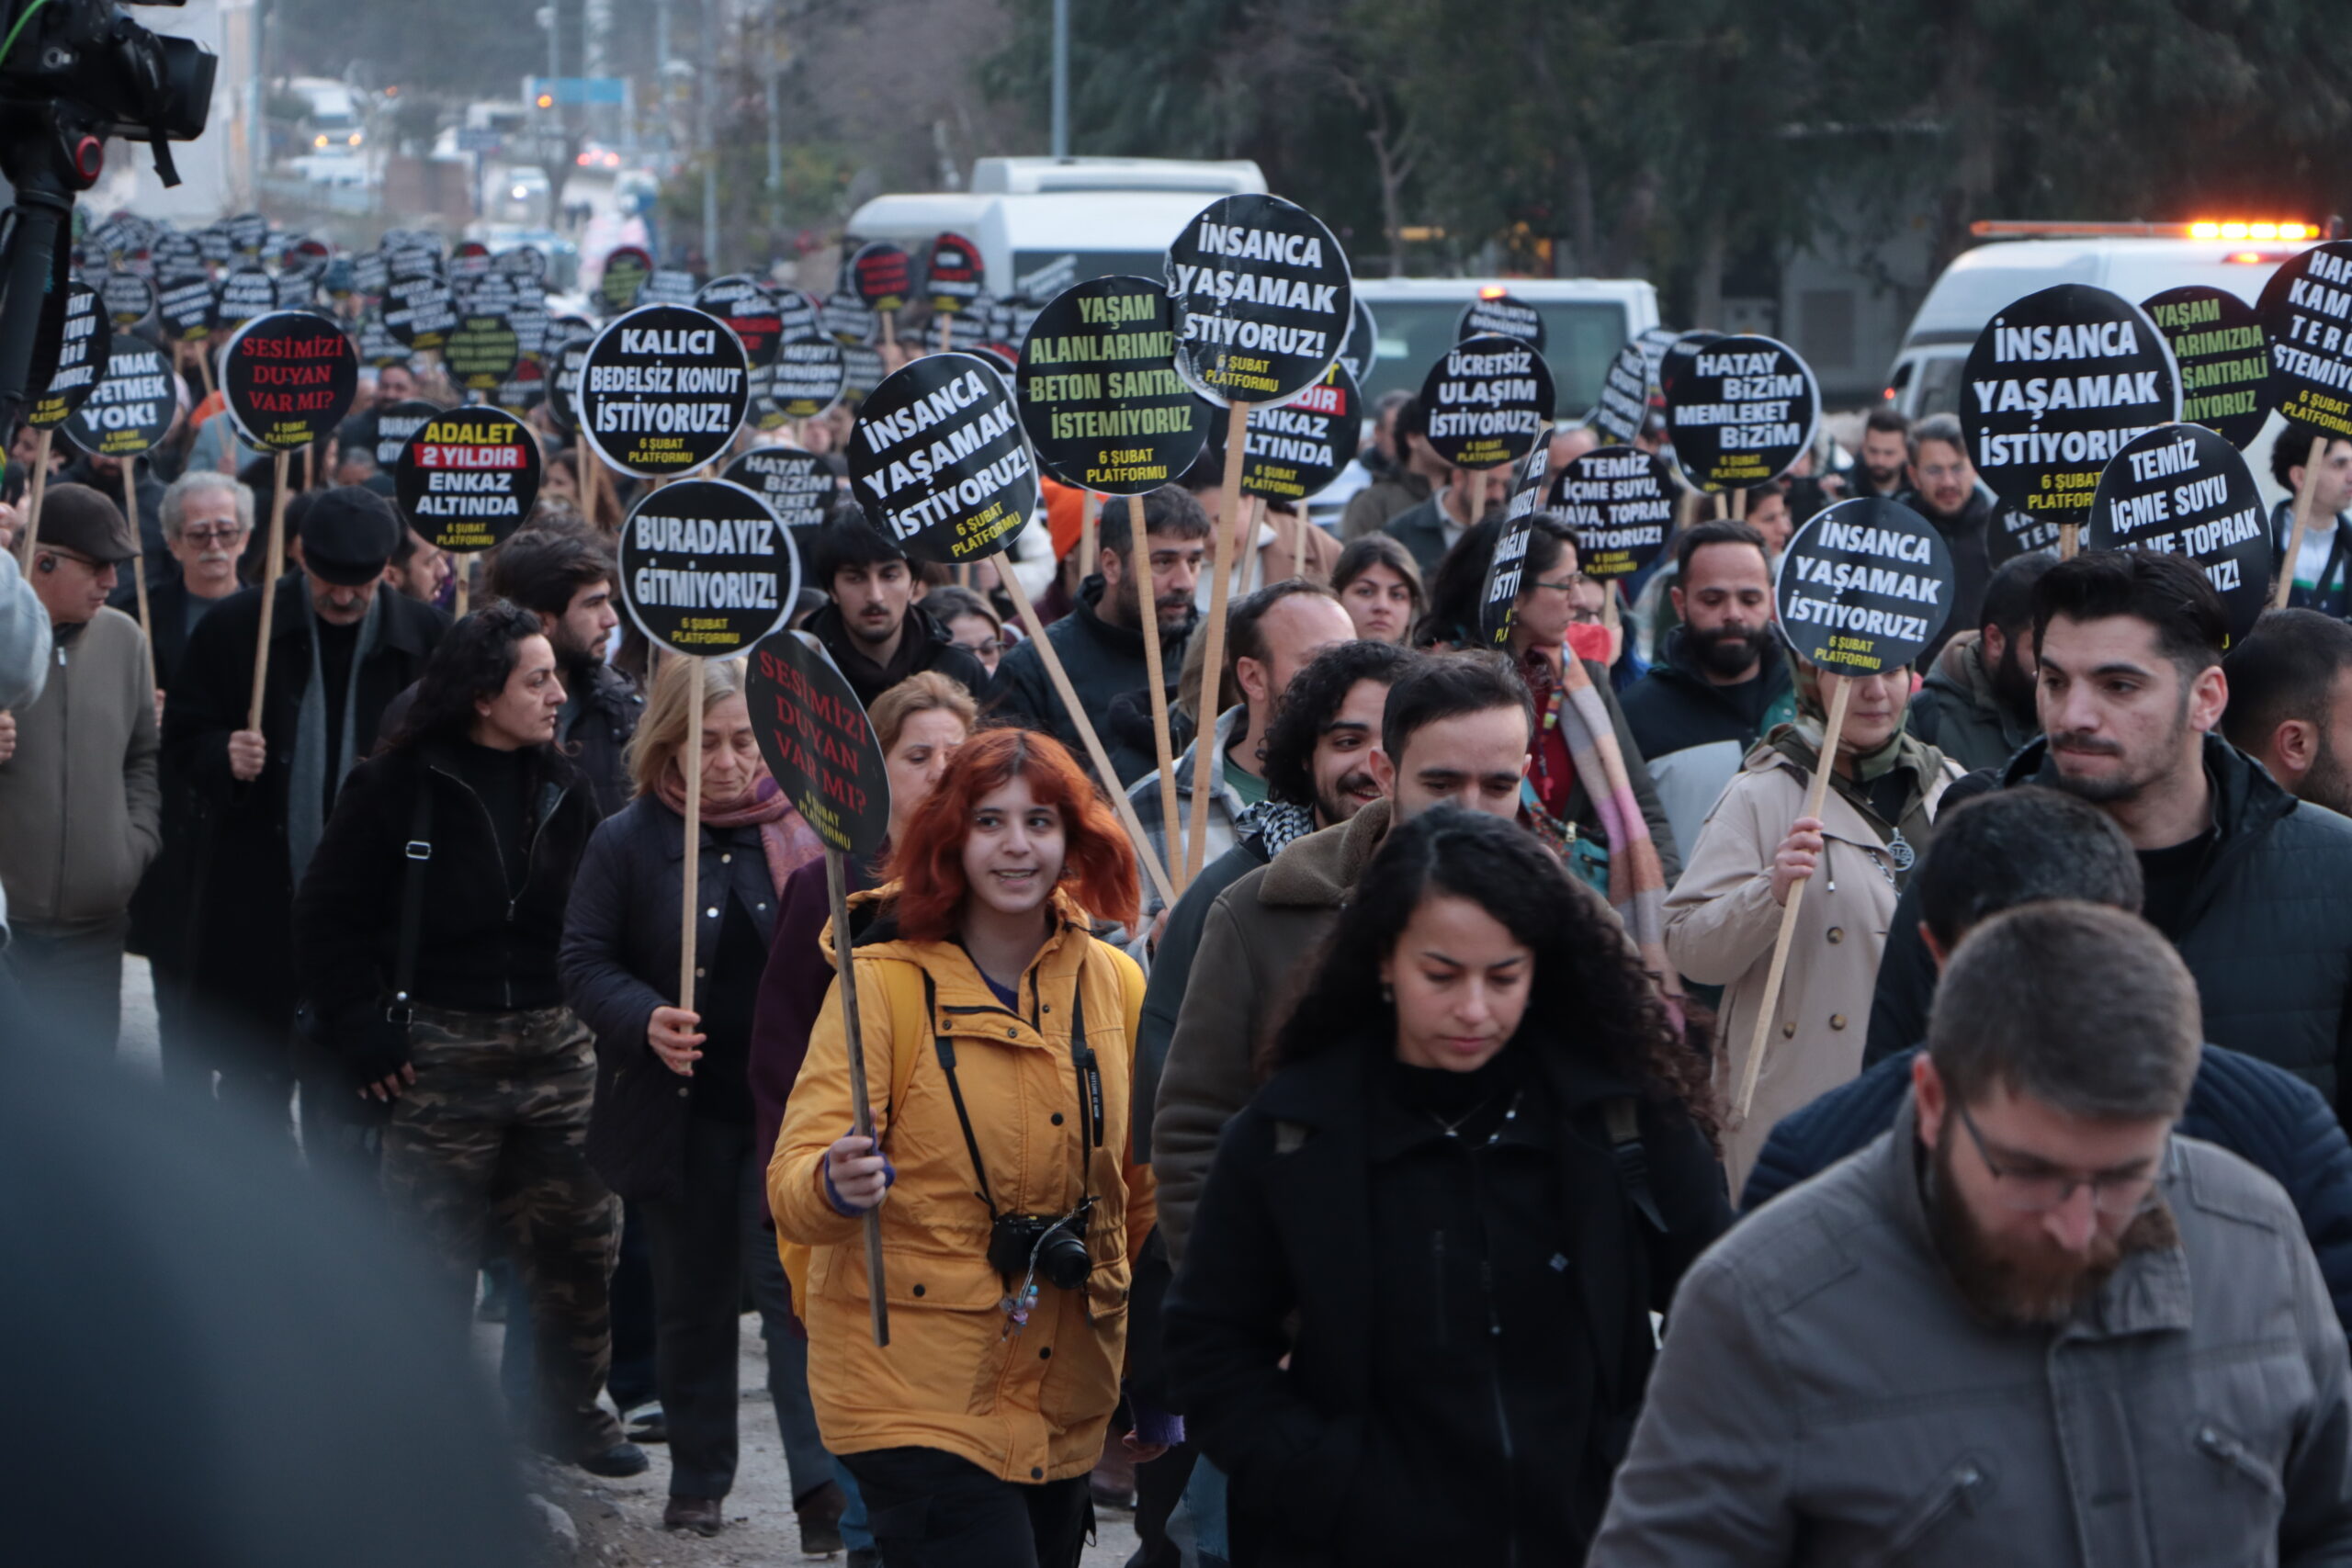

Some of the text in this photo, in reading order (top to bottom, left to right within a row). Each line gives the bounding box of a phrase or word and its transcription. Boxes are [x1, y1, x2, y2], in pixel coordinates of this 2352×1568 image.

[1198, 213, 1323, 268] İNSANCA
[1175, 264, 1339, 313] YAŞAMAK
[1078, 294, 1155, 330] YAŞAM
[2153, 299, 2221, 331] YAŞAM
[242, 334, 345, 358] SESİMİZİ
[621, 329, 716, 355] KALICI
[1183, 309, 1327, 358] STİYORUZ!
[1995, 317, 2140, 363] İNSANCA
[253, 365, 332, 385] DUYAN
[1216, 355, 1271, 374] 6 ŞUBAT
[1447, 346, 1532, 377] ÜCRETSİZ
[1696, 351, 1781, 377] HATAY
[2181, 350, 2269, 389] SANTRALİ
[590, 359, 673, 393] BEDELSİZ
[676, 367, 741, 393] KONUT
[1029, 374, 1101, 402] BETON
[1204, 369, 1279, 392] PLATFORMU
[249, 390, 334, 412] VAR MI?
[1439, 379, 1537, 408] ULAŞIM
[1973, 370, 2161, 420] YAŞAMAK
[2299, 389, 2351, 415] 6 ŞUBAT
[81, 402, 158, 432] YOK!
[596, 394, 731, 433] İSTİYORUZ!
[859, 369, 989, 455] İNSANCA
[1052, 403, 1193, 439] İSTEMİYORUZ
[1429, 407, 1541, 437] İSTİYORUZ!
[1675, 400, 1791, 425] MEMLEKET
[424, 423, 517, 444] ADALET
[639, 438, 684, 451] 6 ŞUBAT
[423, 446, 438, 466] 2
[442, 446, 518, 467] YILDIR
[628, 452, 693, 463] PLATFORMU
[862, 400, 1016, 500] YAŞAMAK
[1099, 448, 1154, 466] 6 ŞUBAT
[1223, 433, 1333, 467] LTINDA
[2129, 435, 2200, 483] TEMİZ
[745, 456, 816, 475] HATAY
[1087, 466, 1168, 483] PLATFORMU
[1254, 465, 1297, 480] 6 ŞUBAT
[1578, 451, 1651, 479] TEMİZ
[428, 472, 512, 491] ENKAZ
[886, 445, 1031, 541] İSTİYORUZ!
[1242, 476, 1305, 496] PLATFORMU
[1565, 477, 1661, 503] İÇME SUYU,
[2041, 471, 2102, 491] 6 ŞUBAT
[415, 495, 519, 515] ALTINDA
[760, 491, 820, 508] LEKET
[1609, 501, 1671, 525] TOPRAK
[2028, 491, 2096, 510] PLATFOR
[2110, 473, 2228, 534] İÇME SUYU
[447, 523, 487, 535] 6 ŞUBAT
[956, 502, 1004, 536] 6 ŞUBAT
[2181, 507, 2261, 558] TOPRAK
[436, 535, 494, 546] PLATFORMU
[635, 515, 775, 555] BURADAYIZ
[951, 511, 1022, 558] PLATFORMU
[1578, 526, 1662, 549] TİYORUZ!
[1818, 513, 1930, 565] İNSANCA
[635, 558, 777, 609] GİTMİYORUZ!
[1795, 556, 1943, 604] YAŞAMAK
[682, 617, 729, 631] 6 ŞUBAT
[1786, 590, 1928, 642] İSTİYORUZ!
[672, 631, 740, 644] PLATFORMU
[1828, 636, 1874, 653] 6 ŞUBAT
[1814, 647, 1882, 670] PLATFORMU
[759, 649, 867, 747] SESİMİZİ
[775, 694, 859, 776] DUYAN
[773, 729, 867, 815] VAR MI?
